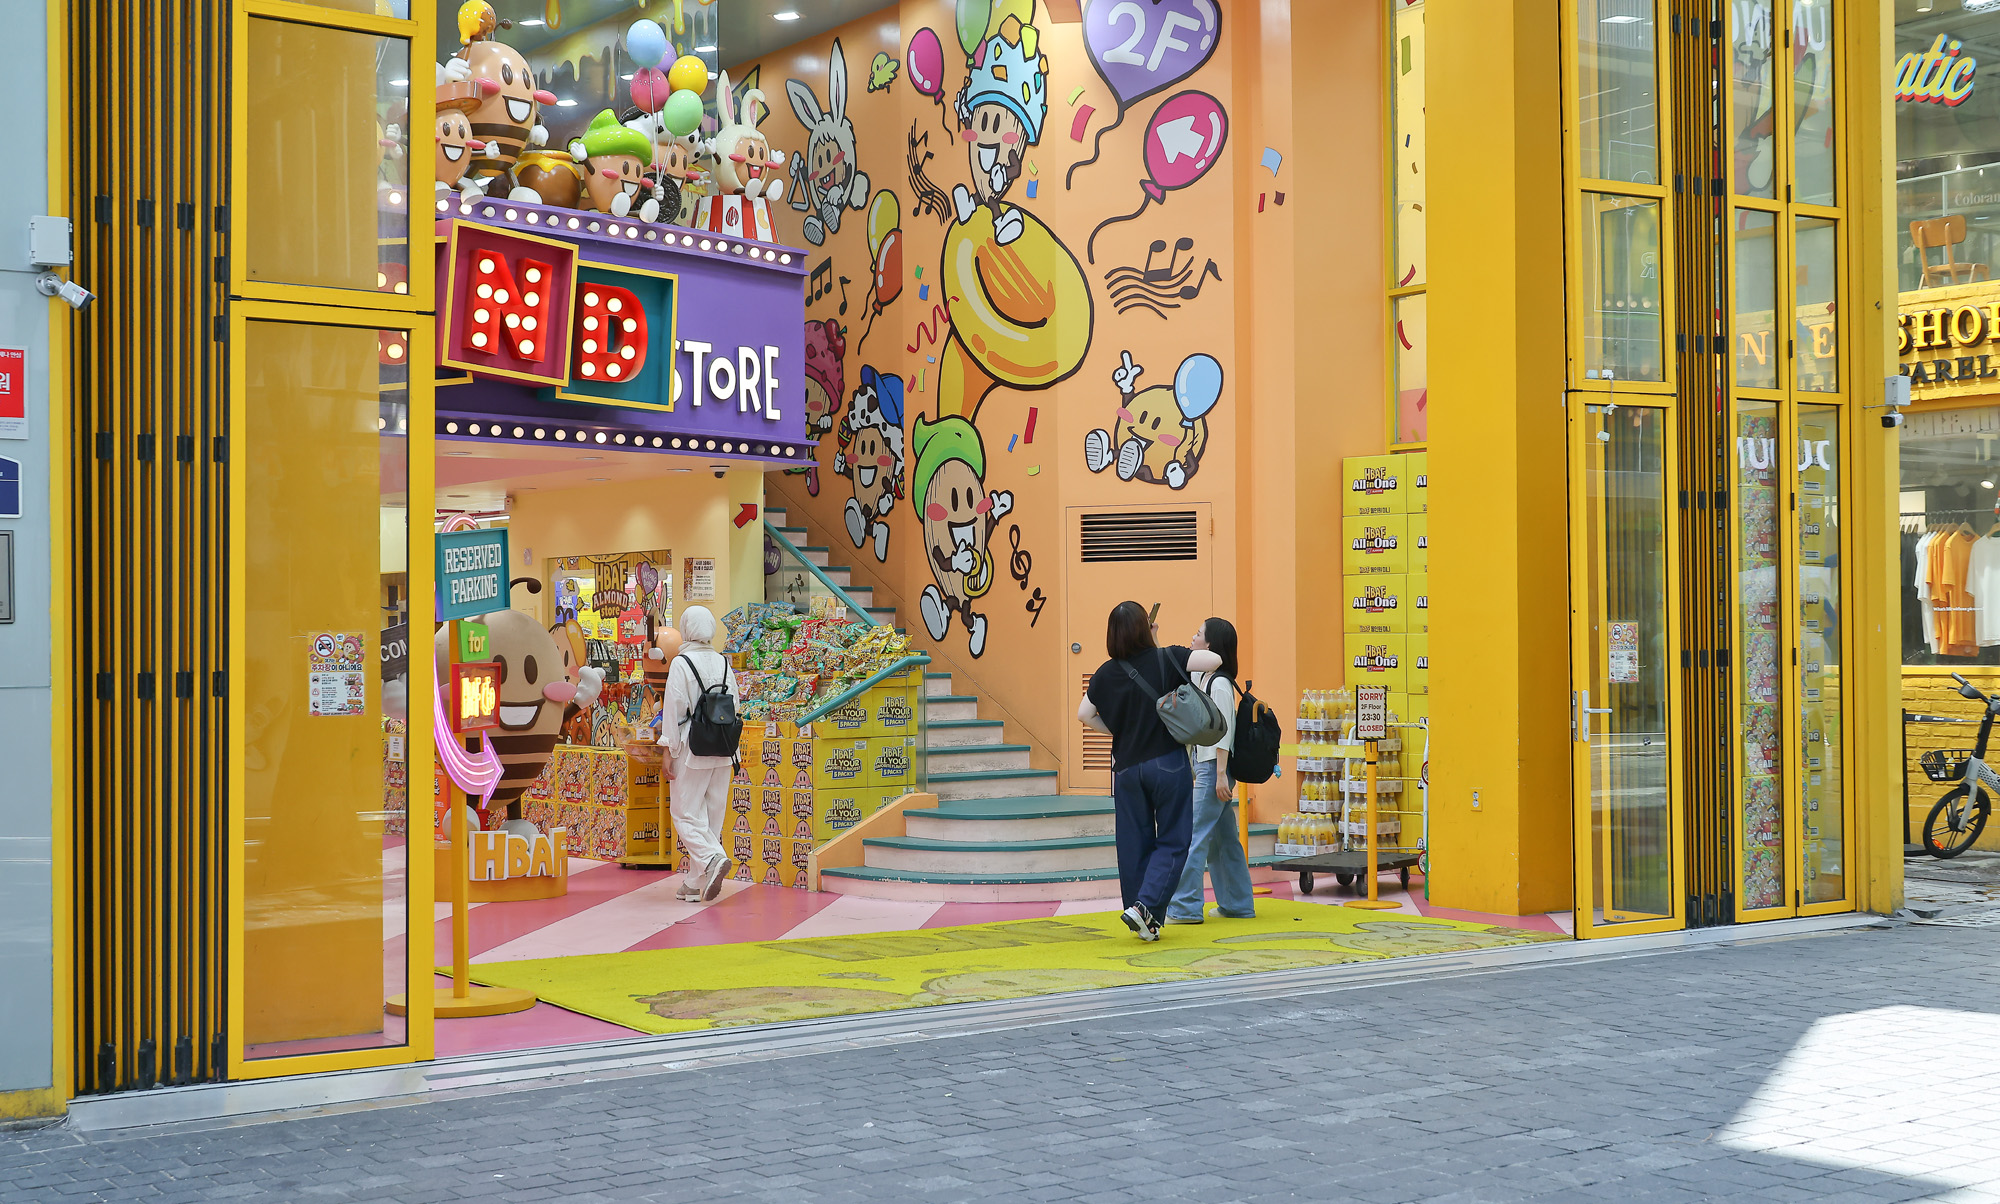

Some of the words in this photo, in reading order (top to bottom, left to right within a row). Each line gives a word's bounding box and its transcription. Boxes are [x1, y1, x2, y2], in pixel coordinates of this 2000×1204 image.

[1103, 2, 1201, 72] 2F
[1364, 467, 1386, 480] HBAF
[1352, 479, 1367, 491] All
[1374, 478, 1397, 489] One
[1364, 526, 1386, 539] HBAF
[1352, 538, 1367, 550] All
[1374, 537, 1397, 548] One
[445, 543, 502, 574] RESERVED
[595, 560, 628, 592] HBAF
[450, 574, 498, 605] PARKING
[1364, 586, 1386, 599] HBAF
[593, 590, 629, 609] ALMOND
[1352, 597, 1367, 608] All
[1374, 596, 1397, 608] One
[600, 605, 620, 617] store
[468, 631, 486, 653] for
[1365, 645, 1387, 658] HBAF
[1353, 656, 1368, 667] All
[1375, 656, 1398, 667] One
[885, 696, 904, 708] HBAF
[846, 708, 866, 716] YOUR
[890, 707, 911, 715] YOUR
[1362, 713, 1381, 721] 23:30
[763, 741, 780, 753] HBAF
[794, 742, 811, 755] HBAF
[883, 747, 903, 757] HBAF
[833, 748, 854, 759] HBAF
[826, 759, 838, 767] ALL
[635, 776, 647, 784] All
[734, 788, 750, 800] HBAF
[763, 790, 780, 802] HBAF
[794, 793, 811, 805] HBAF
[833, 799, 854, 810] HBAF
[644, 822, 658, 831] HBA
[633, 831, 645, 839] All
[735, 836, 751, 848] HBAF
[764, 839, 780, 852] HBAF
[469, 827, 567, 881] HBAF
